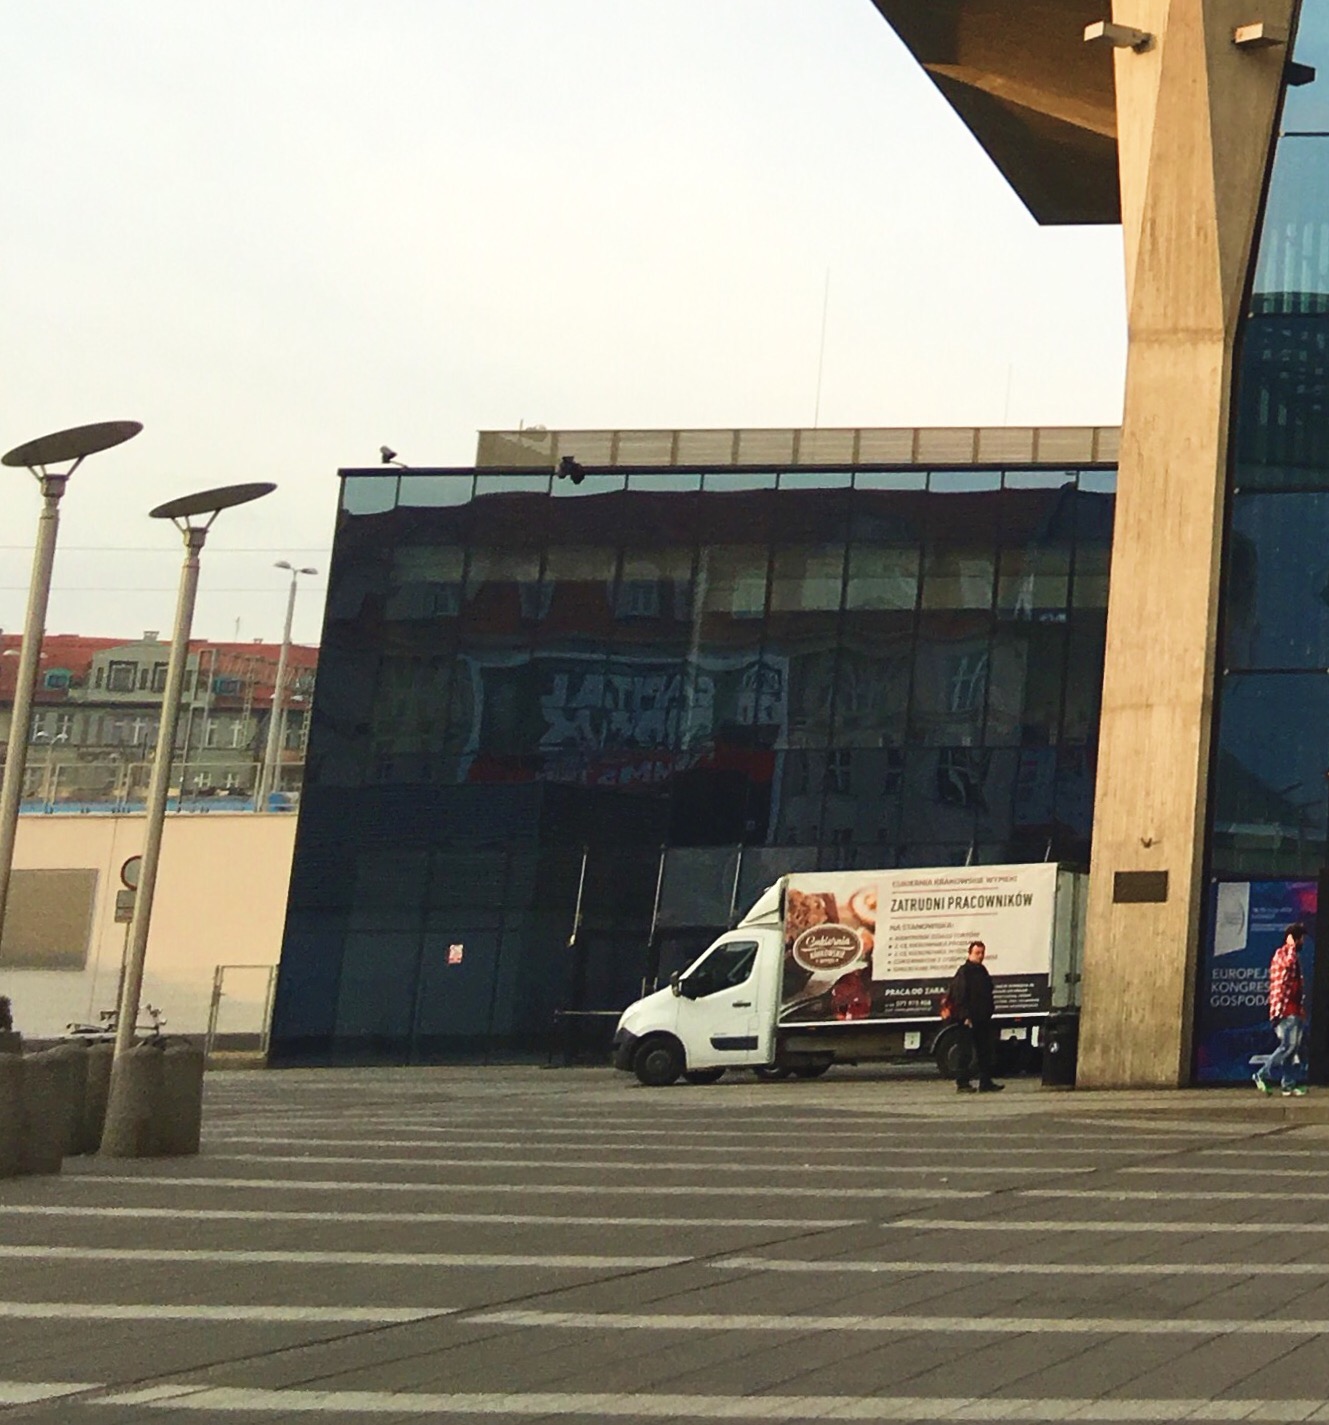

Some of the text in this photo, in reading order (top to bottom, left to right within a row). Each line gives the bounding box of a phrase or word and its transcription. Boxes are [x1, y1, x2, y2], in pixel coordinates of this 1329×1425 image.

[890, 890, 1034, 913] ZATRUDNI PRACOWNIKÓW
[1211, 967, 1271, 980] EUROPEJ
[924, 986, 950, 995] ZARA
